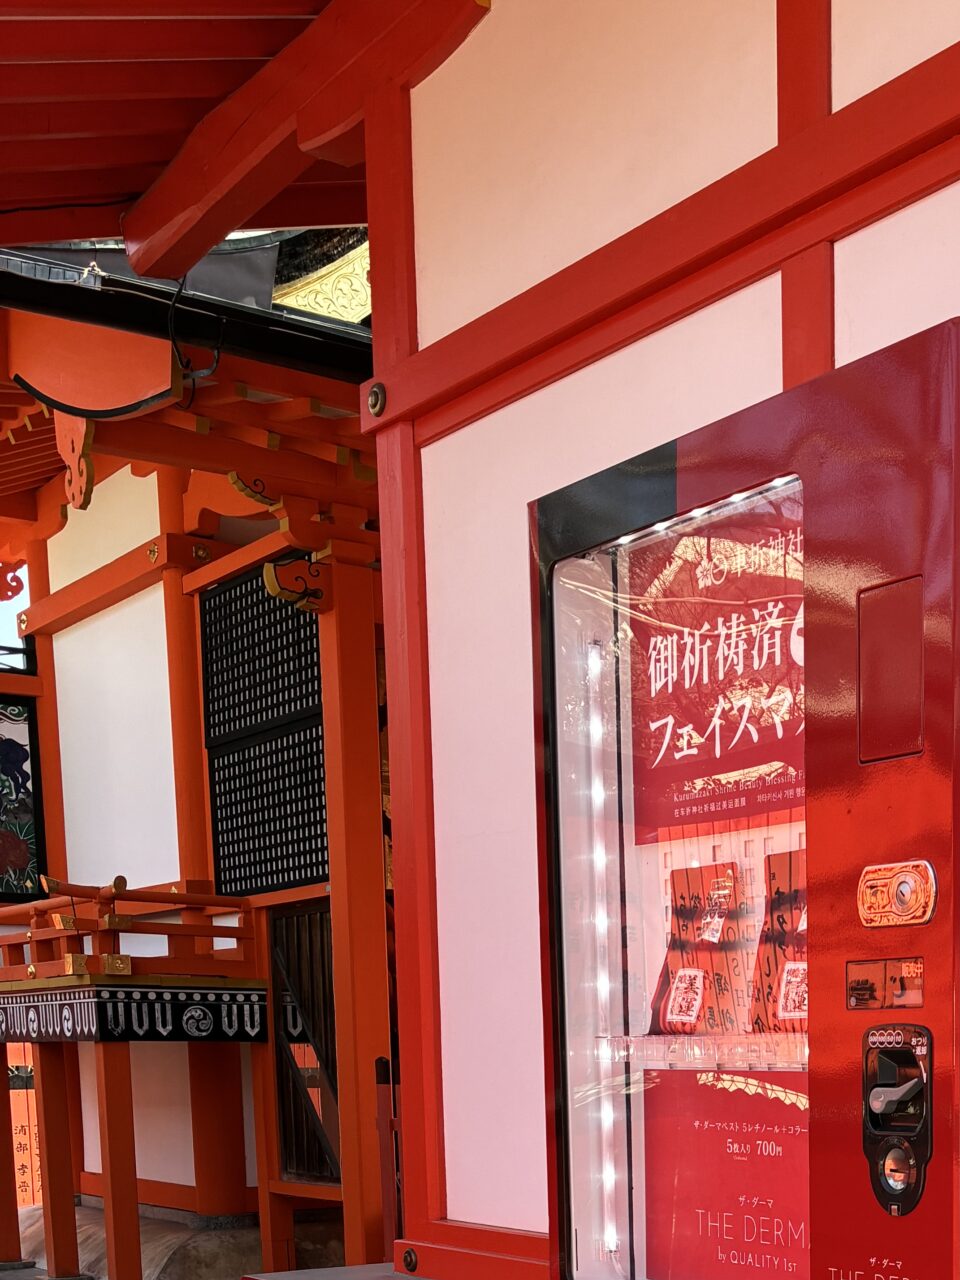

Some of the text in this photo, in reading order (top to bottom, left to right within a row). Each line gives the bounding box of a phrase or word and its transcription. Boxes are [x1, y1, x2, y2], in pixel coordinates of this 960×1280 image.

[715, 785, 737, 796] Shrine
[740, 780, 762, 792] Beauty
[727, 1139, 783, 1157] 5枚入り 700円
[695, 1209, 810, 1249] THE DERM
[718, 1246, 727, 1263] by
[730, 1250, 780, 1270] QUALITY
[869, 1257, 903, 1270] ザ・ダーマ
